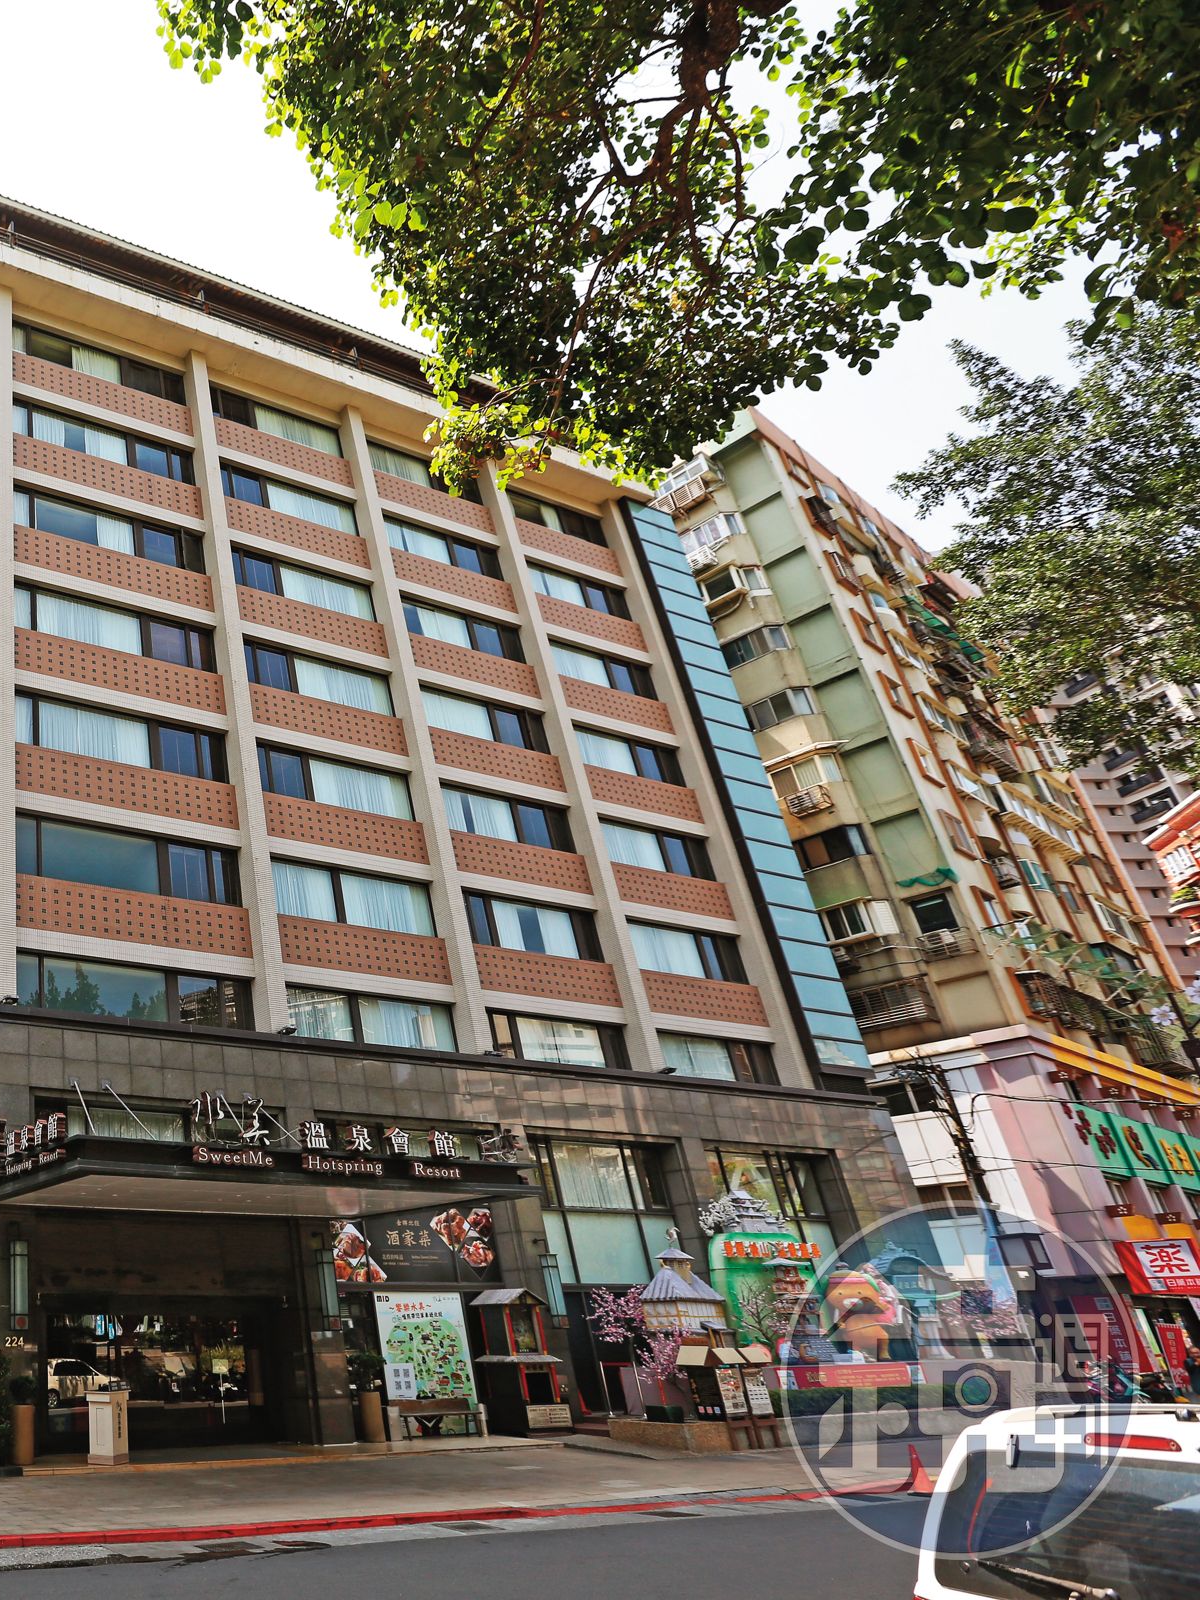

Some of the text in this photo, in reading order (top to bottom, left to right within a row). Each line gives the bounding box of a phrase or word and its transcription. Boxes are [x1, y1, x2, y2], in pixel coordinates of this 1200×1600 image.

[6, 1160, 32, 1176] Hotspring
[39, 1150, 59, 1164] Resort
[197, 1148, 461, 1179] SweetMe Hotspring Resort
[386, 1229, 432, 1247] 酒家菜
[5, 1336, 25, 1348] 224
